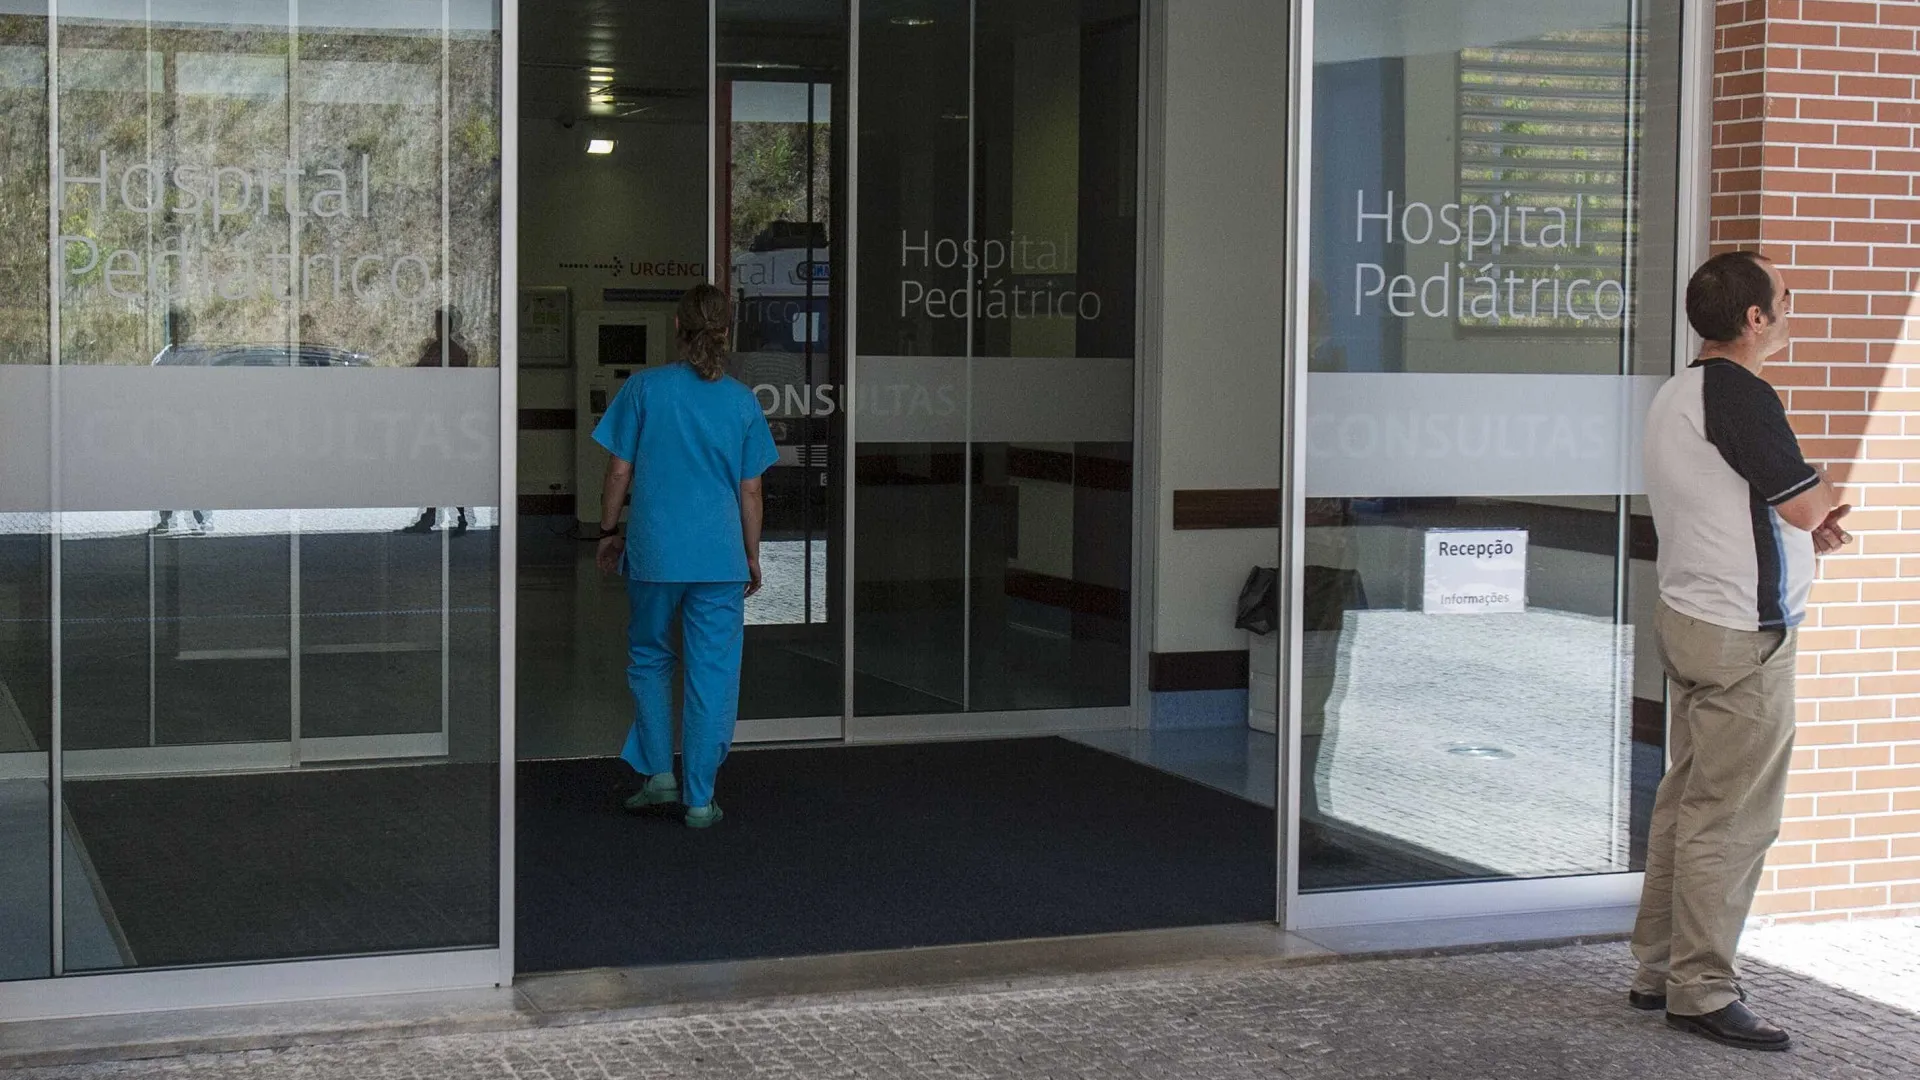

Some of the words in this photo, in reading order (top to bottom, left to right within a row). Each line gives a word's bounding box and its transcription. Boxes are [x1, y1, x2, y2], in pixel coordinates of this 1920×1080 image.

[57, 148, 371, 232] Hospital
[1355, 189, 1583, 261] Hospital
[57, 231, 433, 301] Pediátrico
[629, 260, 705, 277] URGÊNCI
[899, 229, 1069, 280] Hospital
[899, 277, 1102, 320] Pediátrico
[1354, 260, 1626, 320] Pediátrico
[752, 382, 956, 417] ONSULTAS
[1309, 412, 1605, 460] CONSULTAS
[1438, 538, 1514, 559] Recepção
[1439, 592, 1511, 606] Informações
